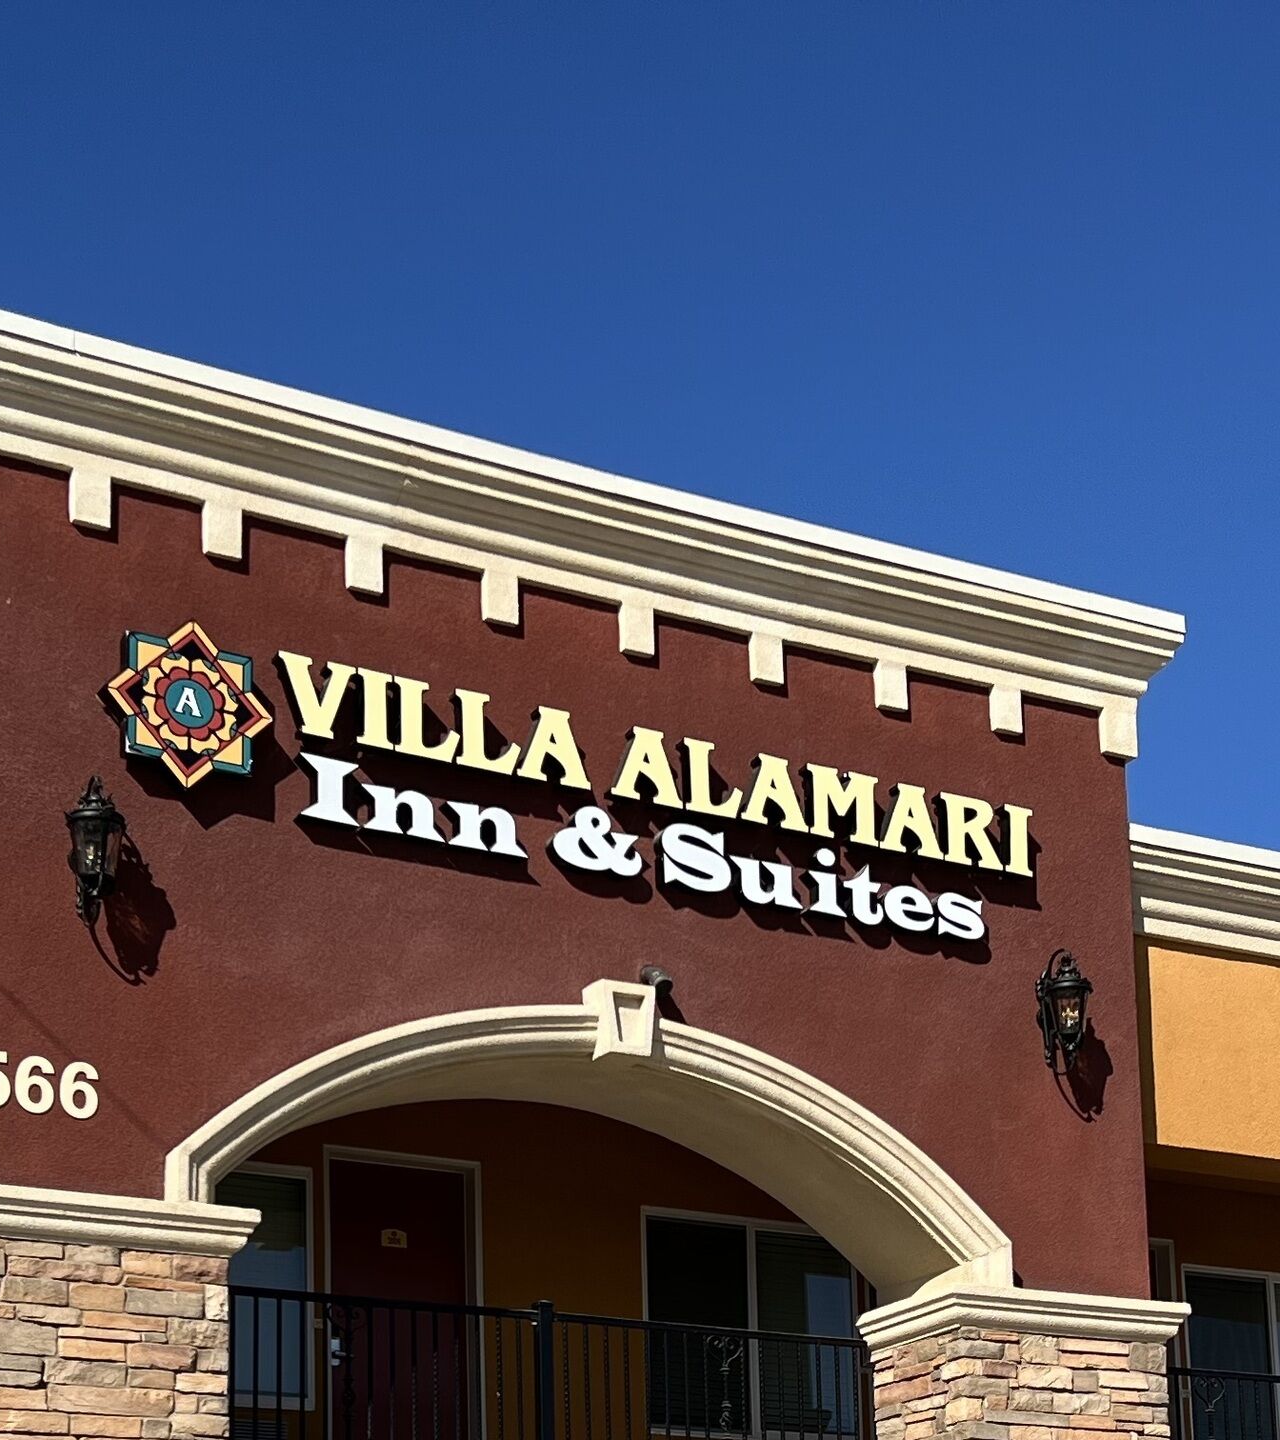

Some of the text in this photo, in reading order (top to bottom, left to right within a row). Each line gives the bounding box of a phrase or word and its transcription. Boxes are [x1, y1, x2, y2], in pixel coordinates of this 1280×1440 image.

[174, 686, 203, 718] A
[277, 650, 1034, 878] VILLA ALAMARI
[300, 751, 986, 941] Inn & Suites
